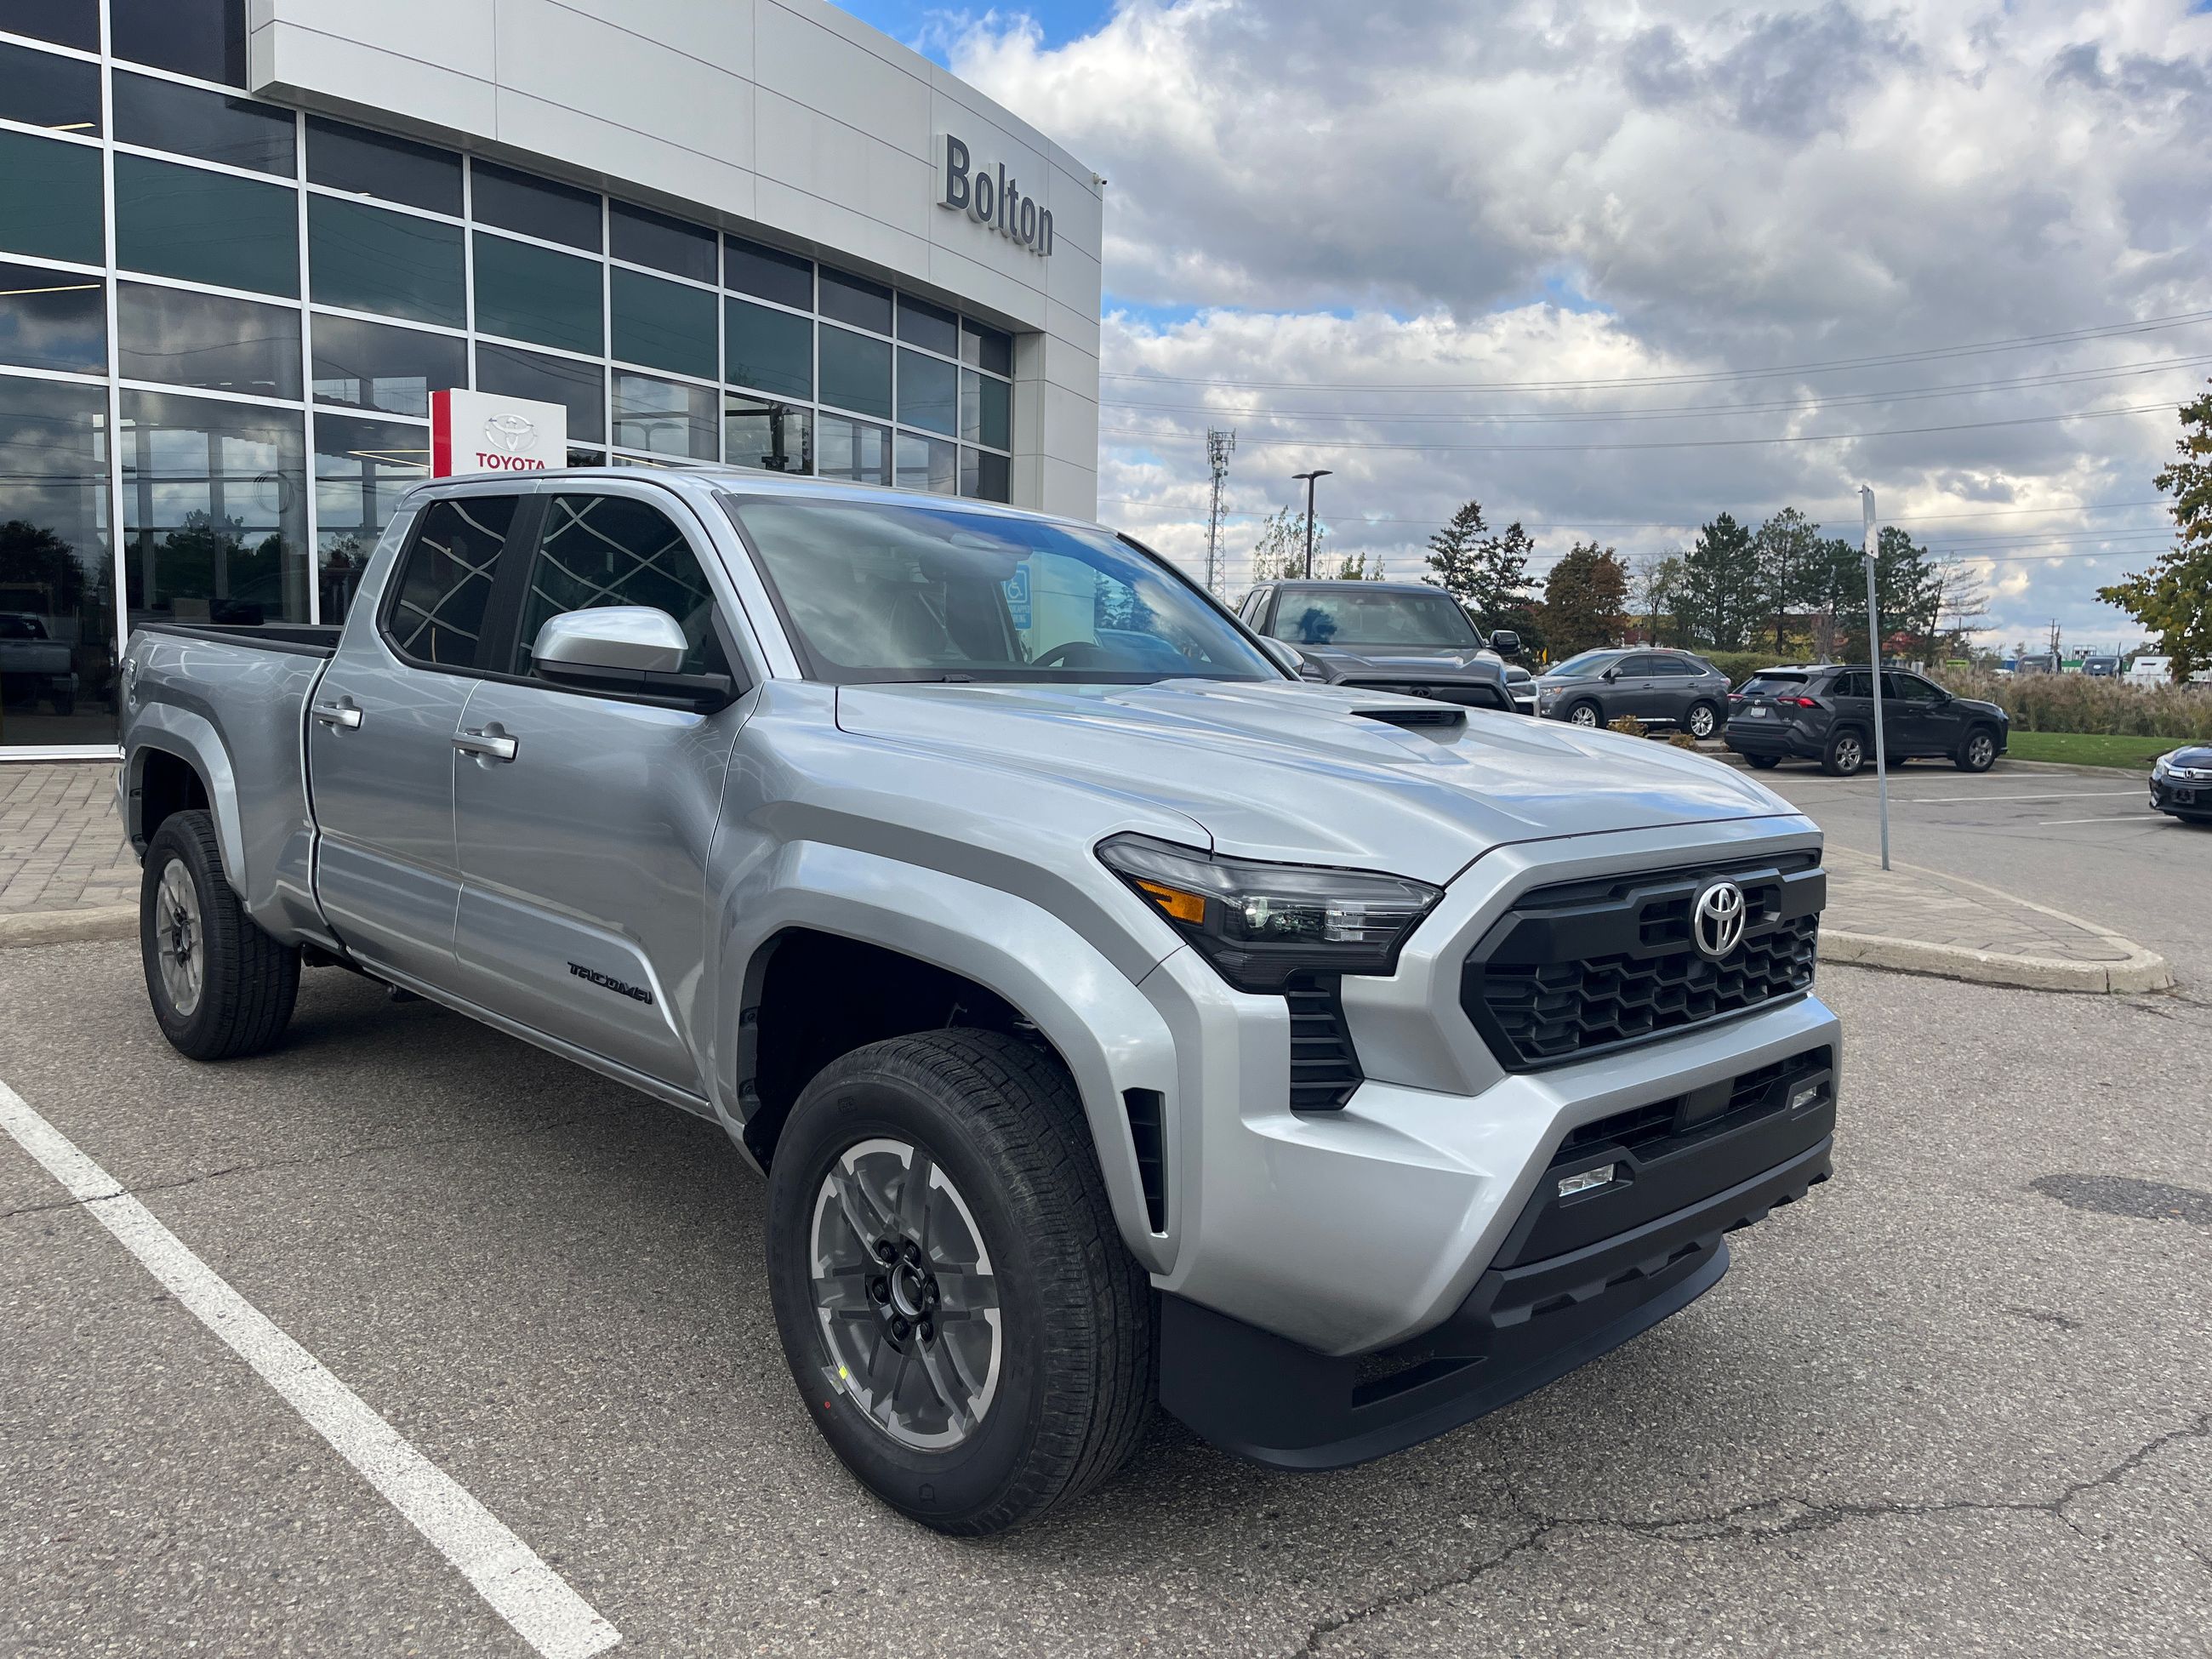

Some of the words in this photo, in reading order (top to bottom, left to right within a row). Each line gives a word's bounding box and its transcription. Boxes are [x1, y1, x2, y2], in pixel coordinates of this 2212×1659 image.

[942, 134, 1053, 256] Bolton
[476, 453, 545, 470] TOYOTA
[567, 961, 653, 1005] TACOMA
